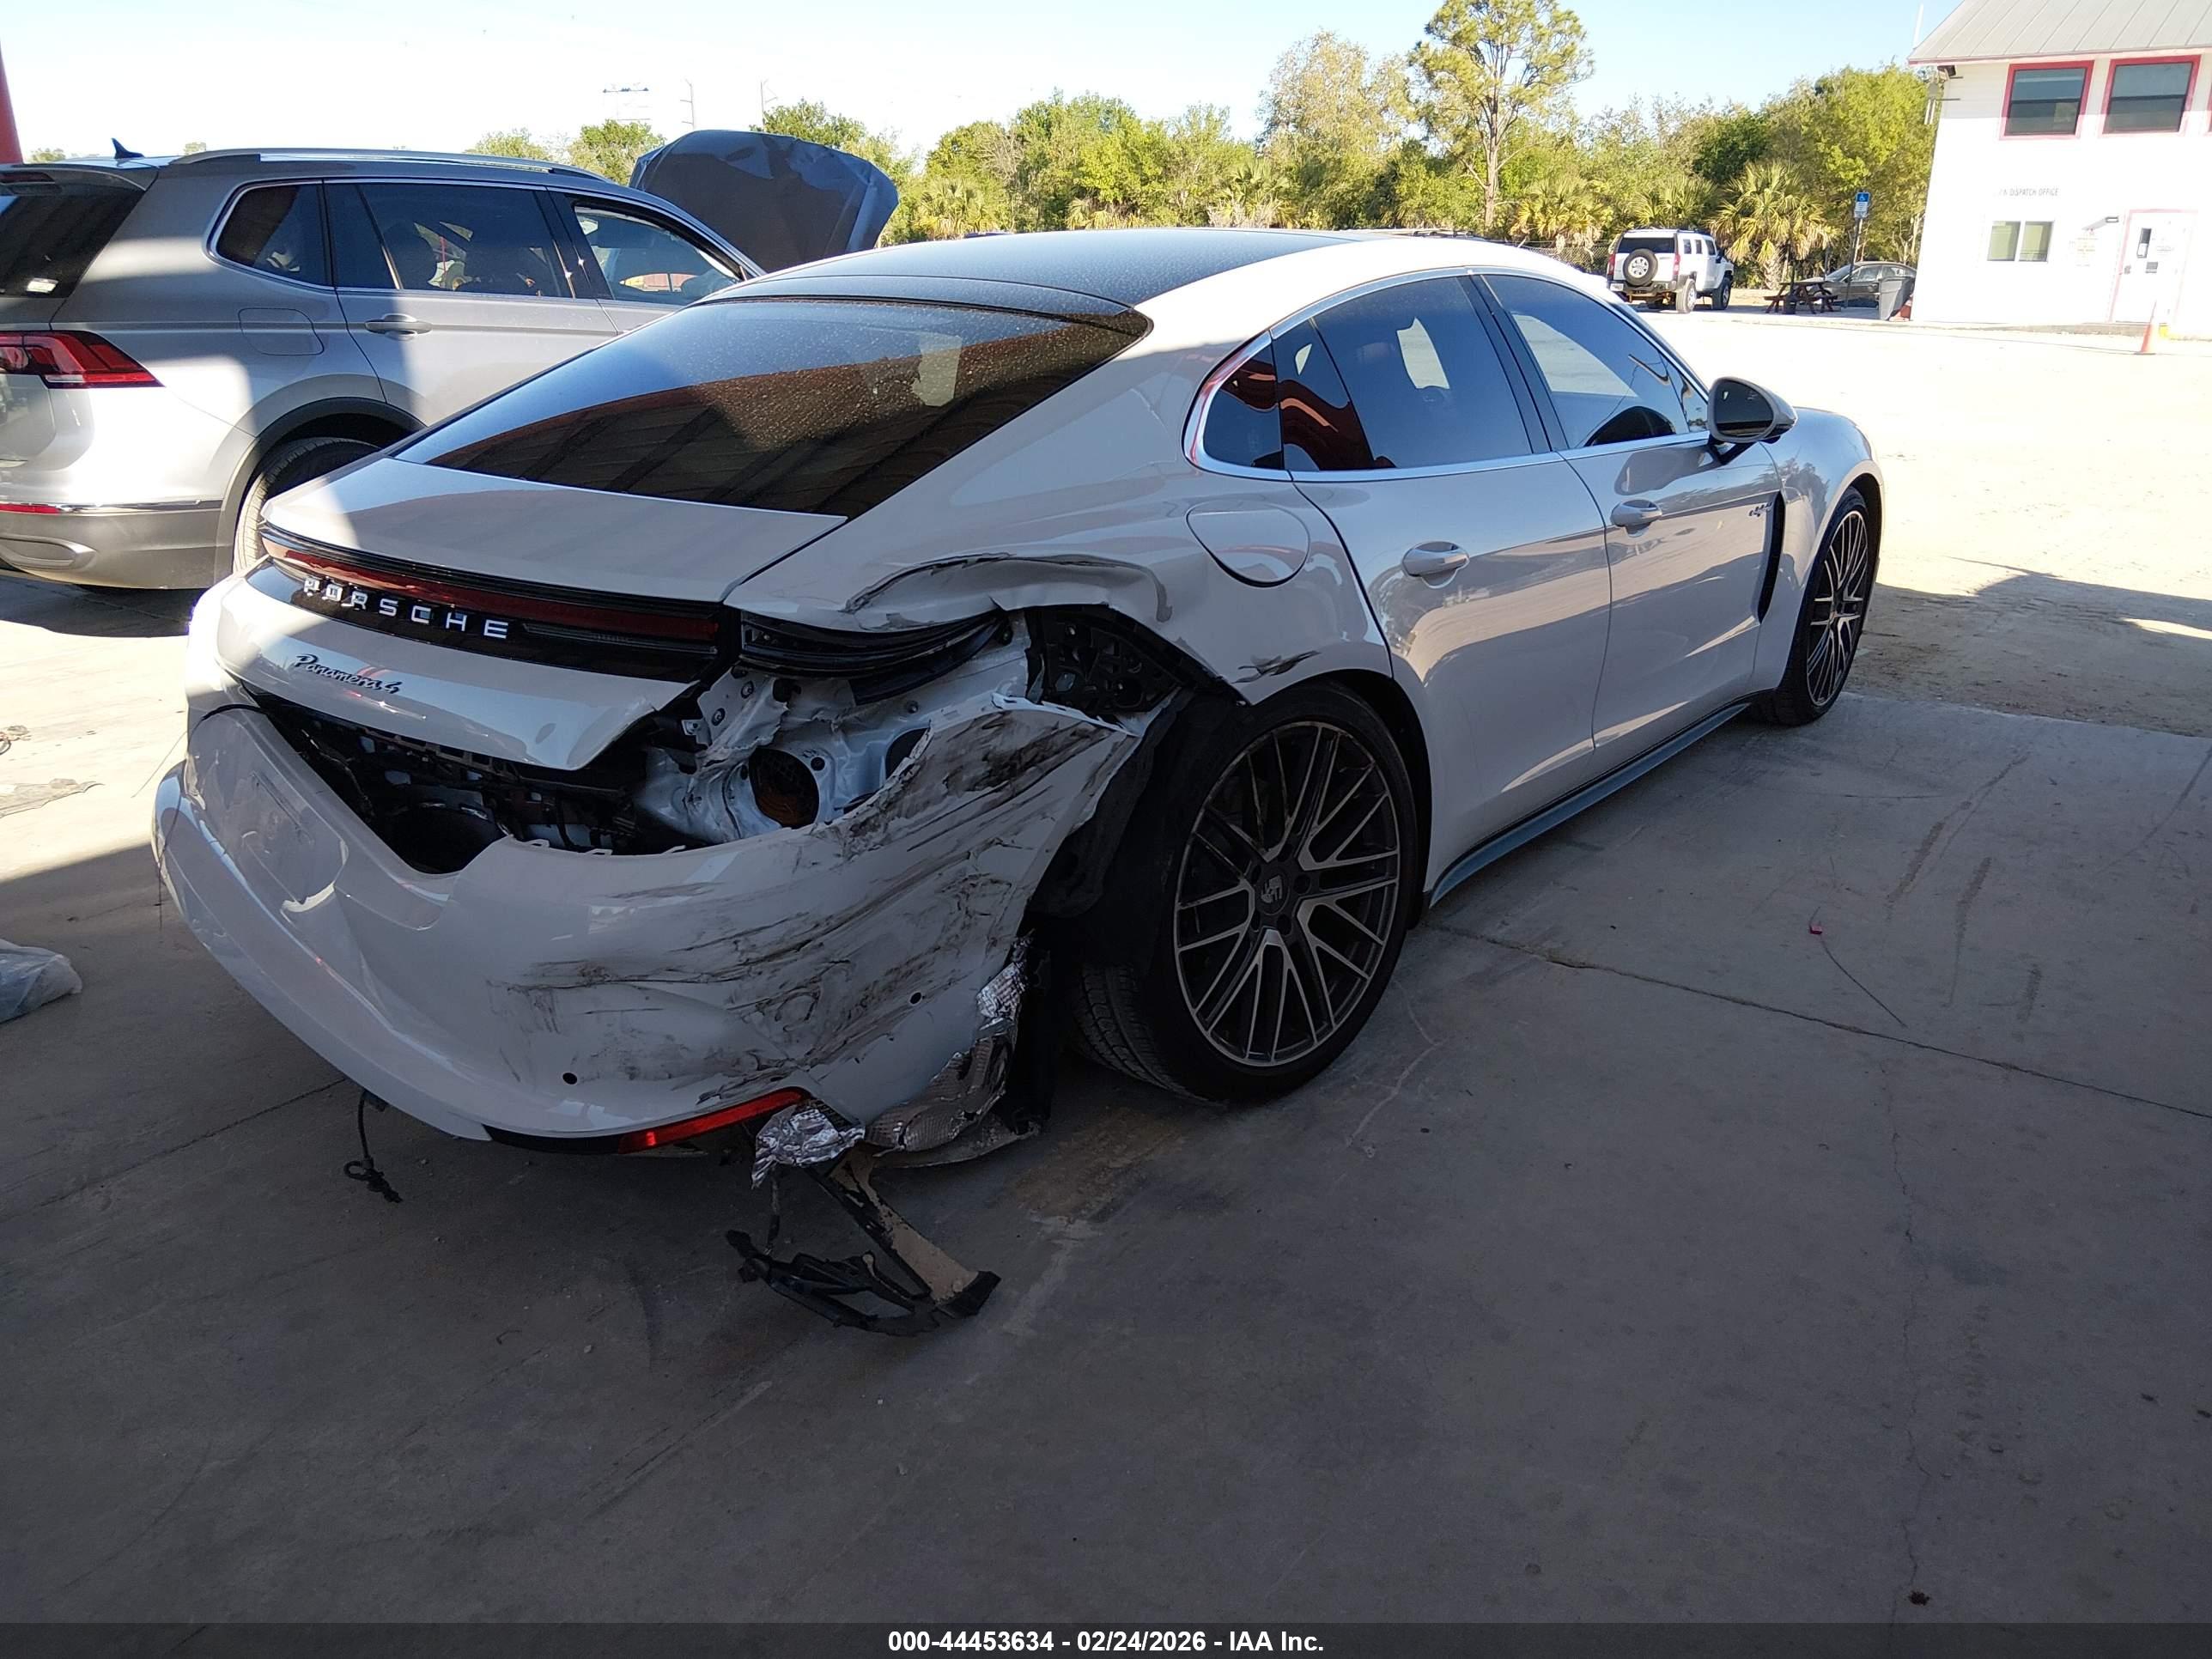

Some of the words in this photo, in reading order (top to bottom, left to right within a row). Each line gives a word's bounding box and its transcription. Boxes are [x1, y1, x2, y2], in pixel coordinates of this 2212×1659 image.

[2039, 187, 2059, 197] OFFICE
[303, 576, 509, 639] PORSCHE
[292, 653, 382, 690] Panamera
